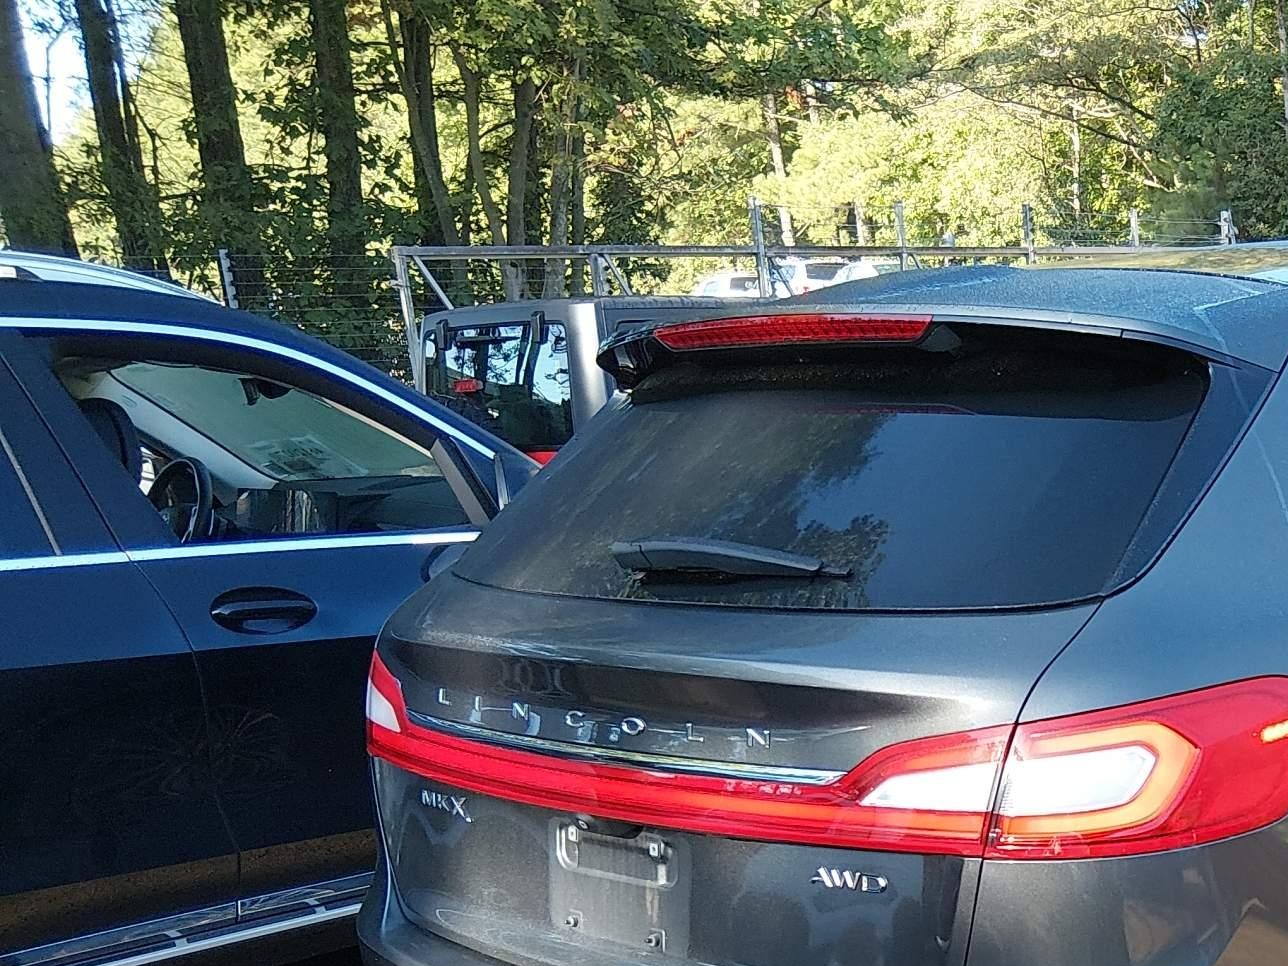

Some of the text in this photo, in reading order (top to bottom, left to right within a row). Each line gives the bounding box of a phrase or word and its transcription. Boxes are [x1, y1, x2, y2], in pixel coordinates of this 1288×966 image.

[438, 687, 771, 749] LINCOLN
[421, 789, 473, 823] MKX
[810, 866, 889, 893] AWD
